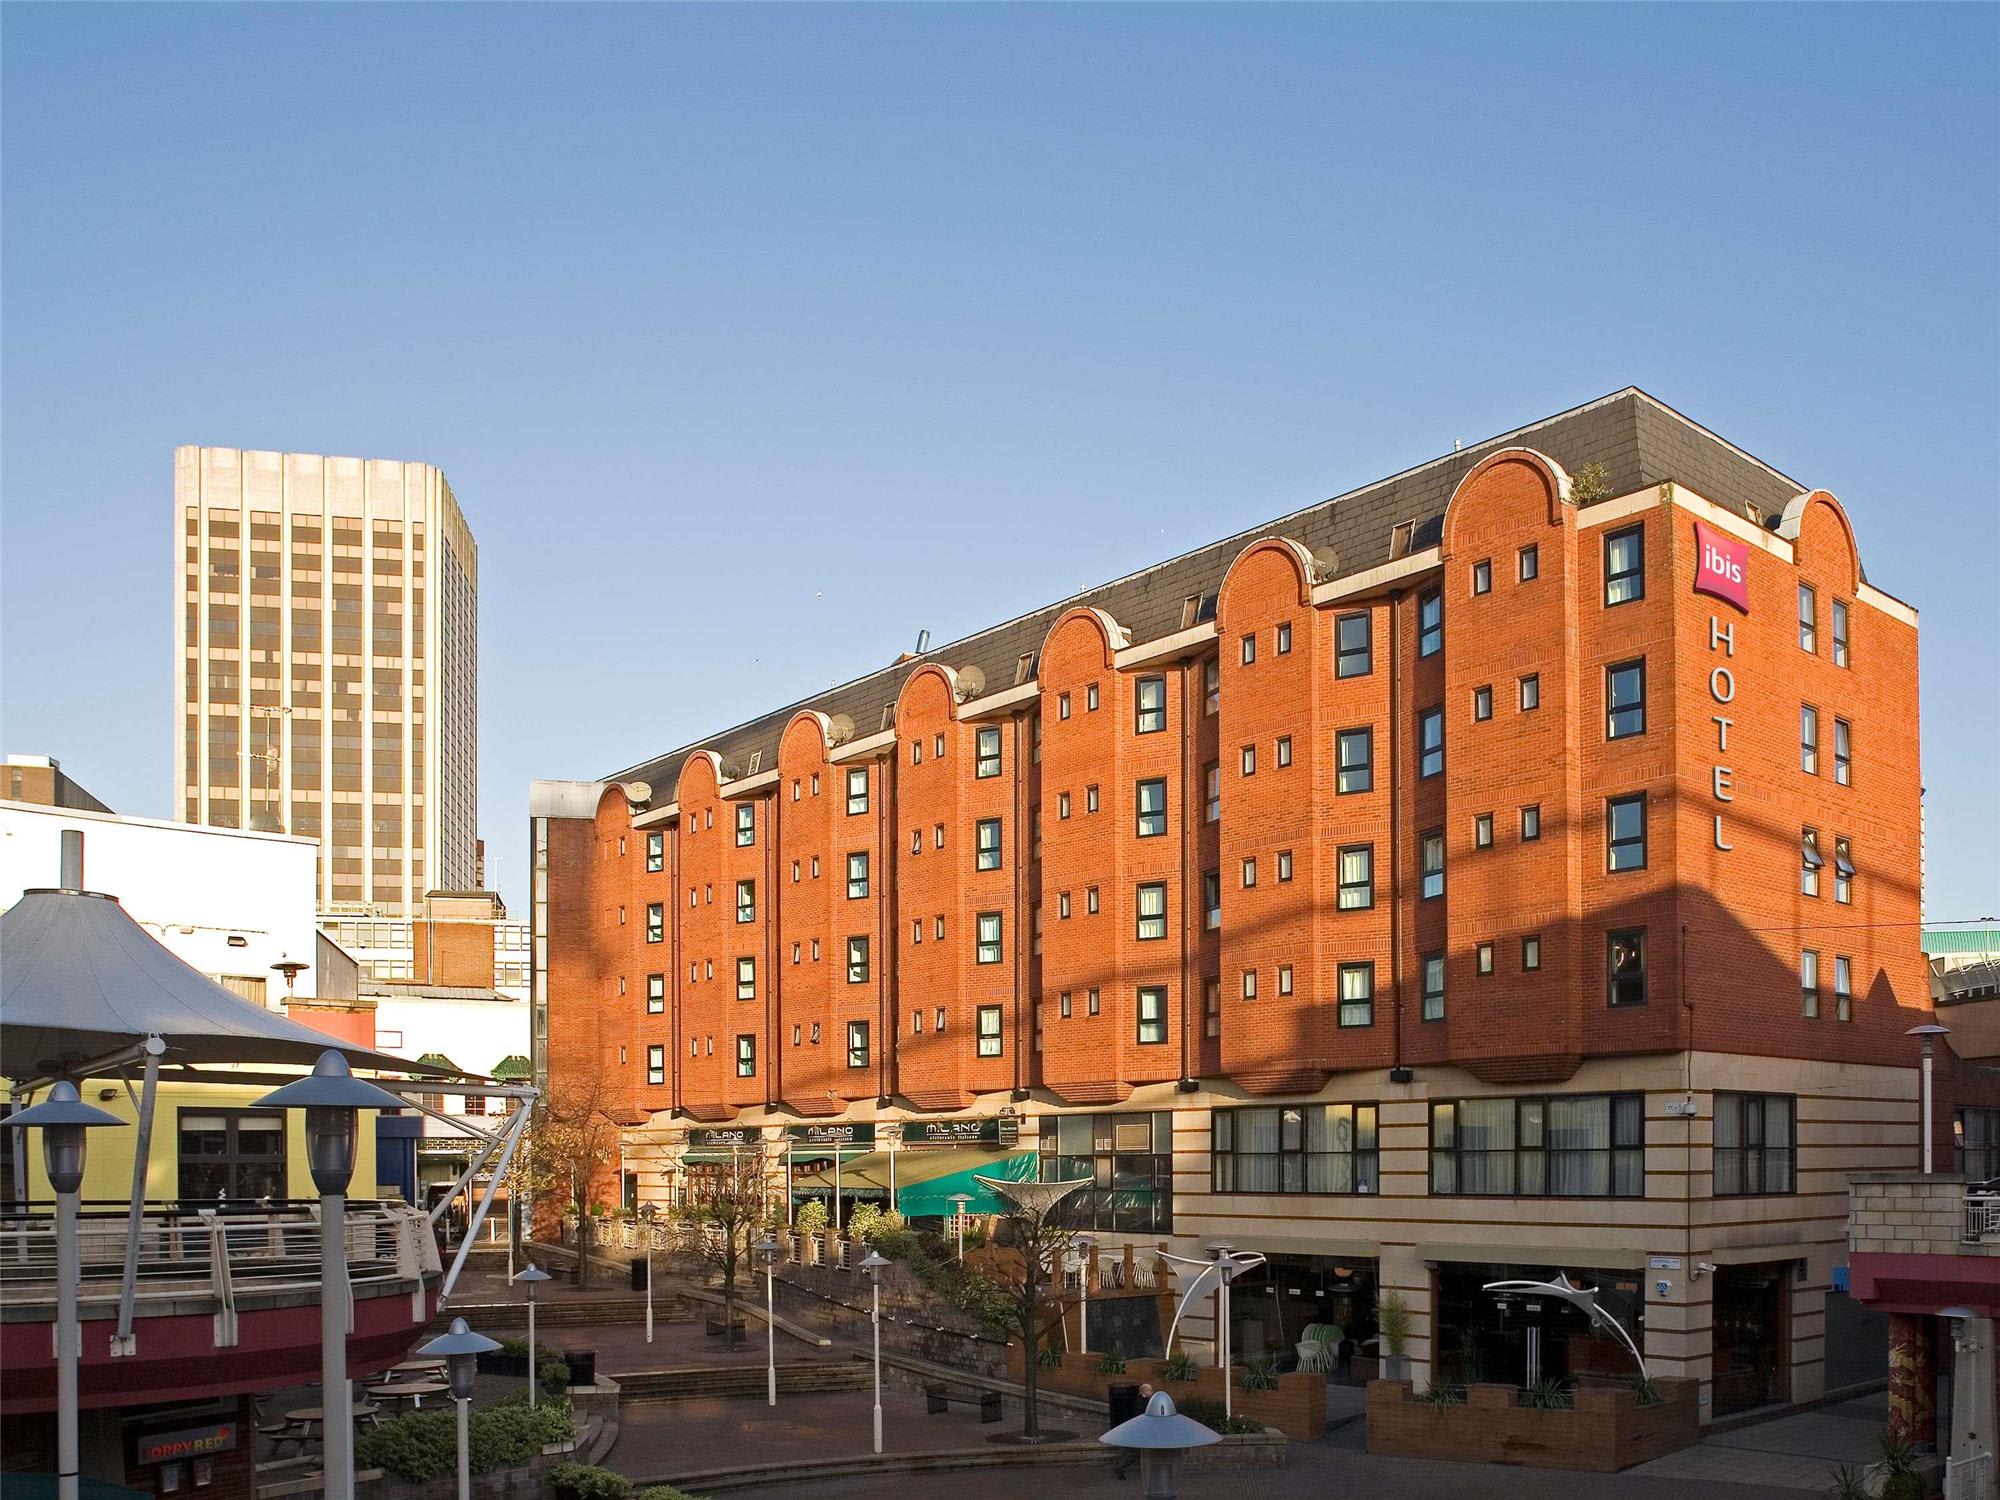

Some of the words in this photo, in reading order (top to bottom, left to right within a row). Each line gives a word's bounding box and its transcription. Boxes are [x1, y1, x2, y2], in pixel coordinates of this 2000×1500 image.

[1705, 544, 1742, 584] ibis
[1711, 615, 1735, 850] HOTEL
[926, 1123, 981, 1132] MLANO
[705, 1130, 744, 1139] MLANO
[194, 1437, 224, 1449] RED
